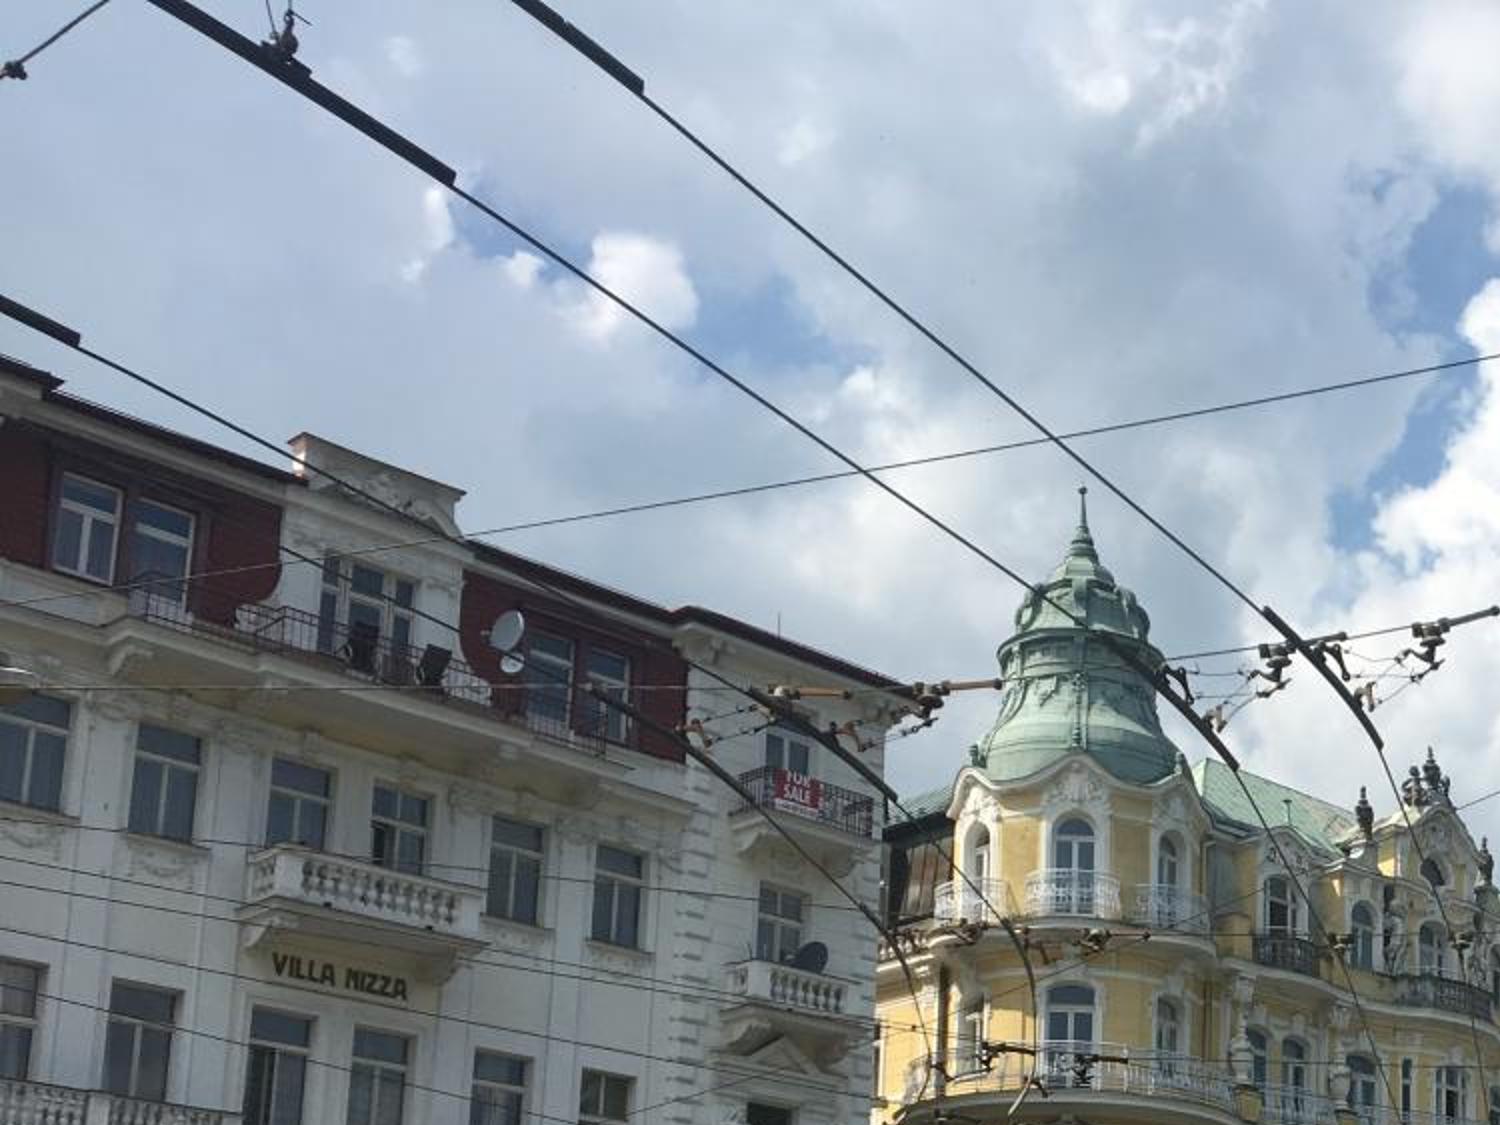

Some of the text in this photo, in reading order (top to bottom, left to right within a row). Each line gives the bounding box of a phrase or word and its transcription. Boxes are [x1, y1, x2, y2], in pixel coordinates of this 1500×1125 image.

[783, 783, 810, 806] SALE
[271, 951, 408, 1001] VILLA NIZZA
